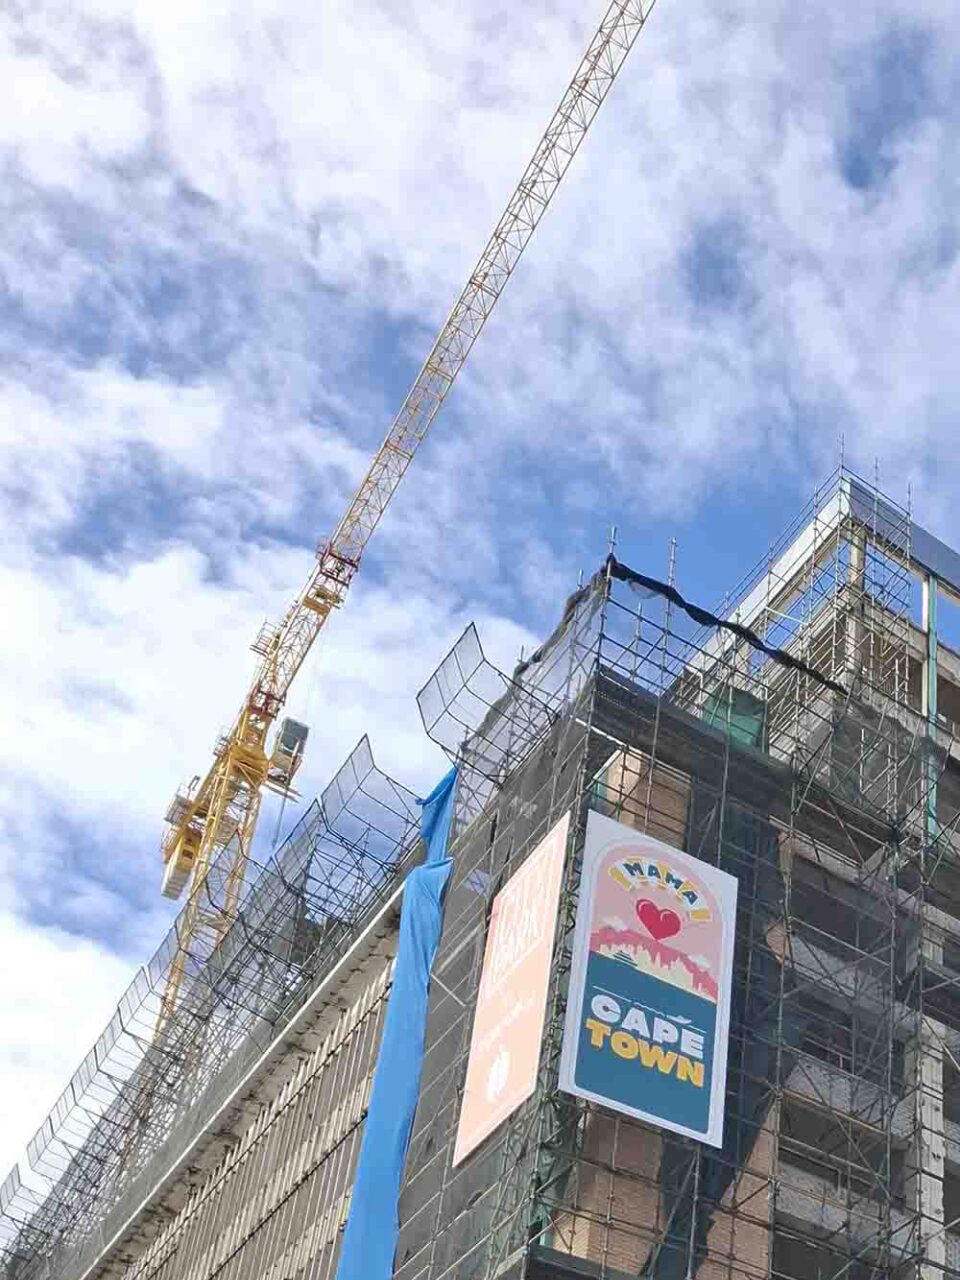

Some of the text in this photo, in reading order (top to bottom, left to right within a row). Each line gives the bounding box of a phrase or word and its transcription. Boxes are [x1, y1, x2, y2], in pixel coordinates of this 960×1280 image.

[623, 861, 699, 905] MAMA
[585, 1017, 705, 1088] TOWN
[590, 994, 705, 1060] CAPE
